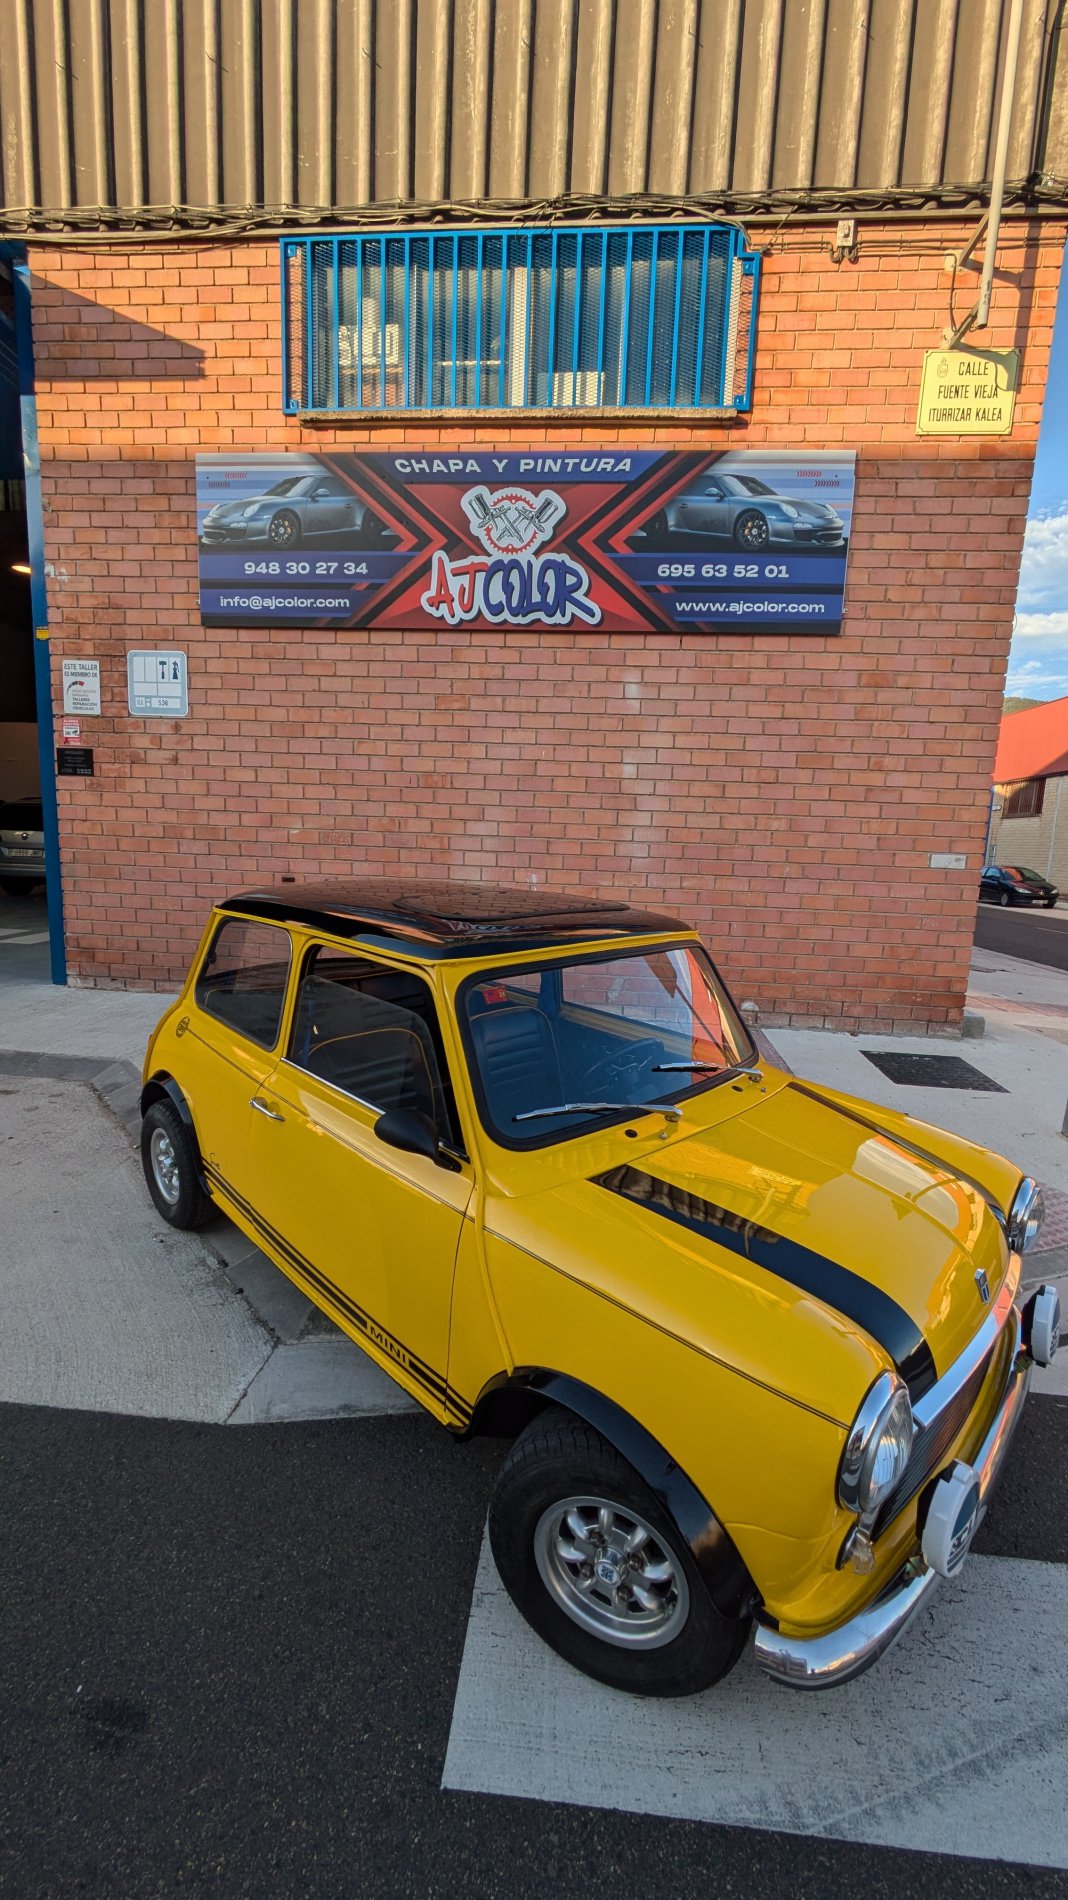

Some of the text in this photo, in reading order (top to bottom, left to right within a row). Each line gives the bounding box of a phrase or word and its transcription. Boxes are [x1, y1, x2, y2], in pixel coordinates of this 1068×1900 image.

[958, 361, 990, 376] CALLE
[938, 384, 998, 399] FUENTE VIEJA
[928, 407, 1002, 422] ITURRIZAR KALEA
[394, 458, 632, 473] CHAPA Y PINTURA
[244, 562, 368, 575] 948 30 27 34
[657, 564, 789, 578] 695 63 52 01
[220, 596, 350, 610] info@ajcolor.com
[675, 601, 825, 615] www.ajcolor.com
[370, 1325, 406, 1363] MINI
